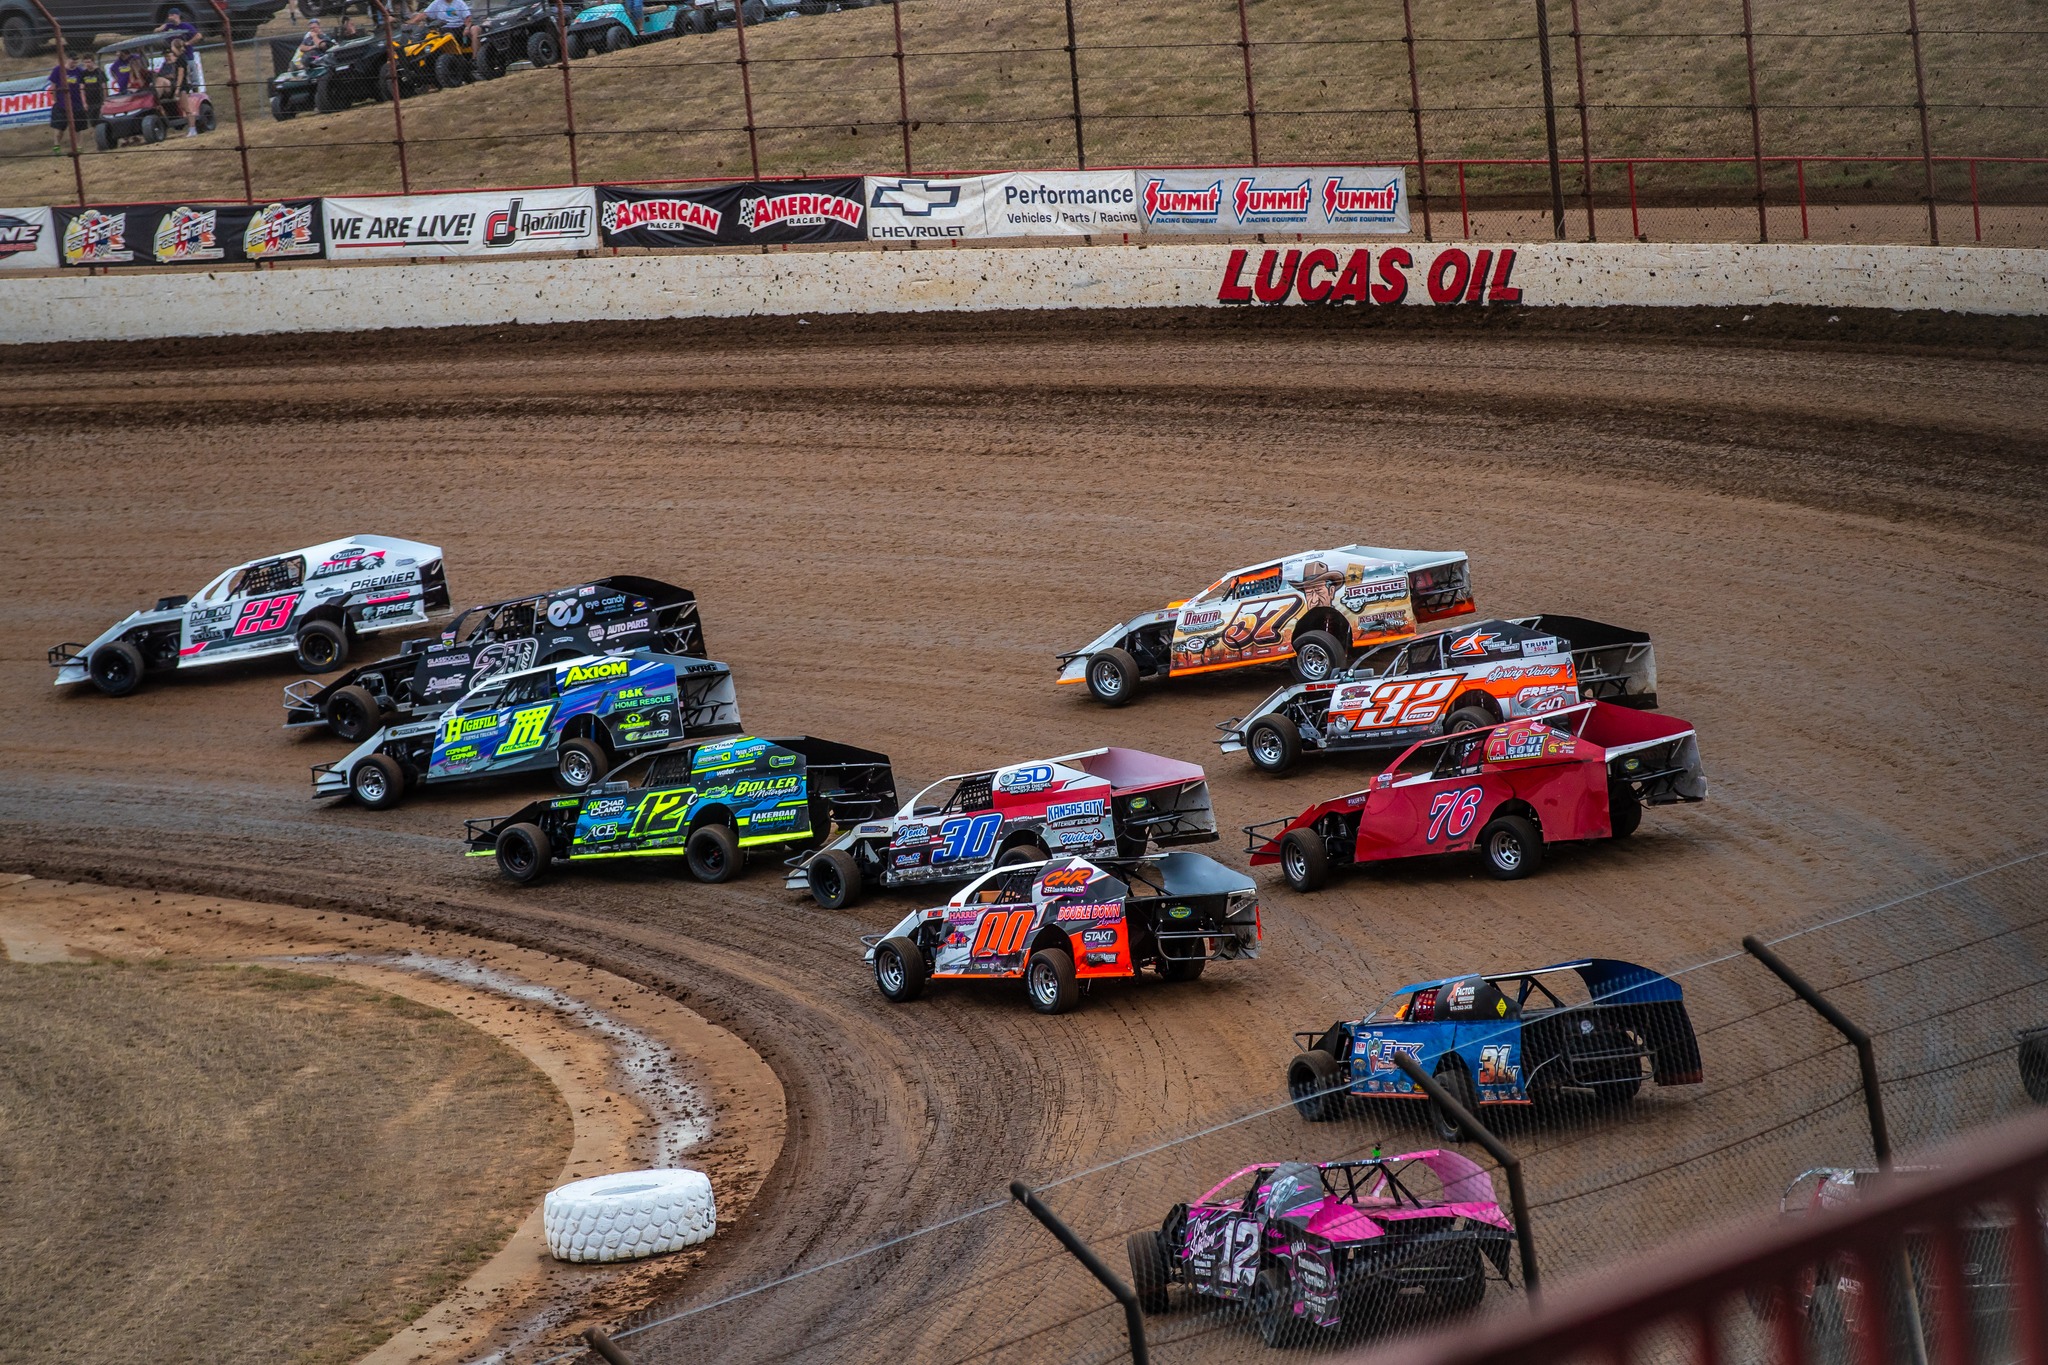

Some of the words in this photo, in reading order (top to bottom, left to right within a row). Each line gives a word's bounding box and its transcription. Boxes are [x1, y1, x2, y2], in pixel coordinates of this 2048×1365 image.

[1005, 184, 1133, 204] Performance
[614, 201, 719, 231] AMERICAN
[753, 195, 861, 227] AMERICAN
[1007, 211, 1052, 223] Vehicles
[1062, 212, 1089, 223] Parts
[1100, 211, 1138, 224] Racing
[331, 218, 361, 240] WE
[367, 216, 413, 239] ARE
[417, 213, 476, 237] LIVE!
[521, 209, 587, 236] RacinDirt
[872, 225, 965, 238] CHEVROLET
[1218, 248, 1412, 303] LUCAS
[1427, 248, 1522, 304] OIL
[317, 560, 357, 575] EAGLE
[351, 571, 415, 590] PREMIER
[1347, 581, 1406, 596] TRIANGLE
[376, 601, 413, 616] RAGE
[585, 600, 600, 609] eye
[601, 594, 627, 605] candy
[233, 593, 300, 636] 23
[1183, 611, 1219, 626] DAKOTA
[1225, 597, 1298, 644] 57
[1359, 610, 1404, 624] ASPHALT
[607, 620, 626, 634] AUTO
[627, 617, 649, 630] PARTS
[1525, 640, 1554, 648] TRUMP
[564, 661, 627, 688] AXIOM
[1486, 665, 1525, 684] Spring
[1526, 665, 1561, 678] Valley
[619, 687, 644, 699] B&K
[1519, 685, 1566, 701] FRESH
[615, 699, 639, 710] HOME
[640, 695, 672, 706] RESCUE
[1537, 697, 1564, 711] CUT
[444, 714, 498, 744] HIGHFILL
[716, 767, 737, 778] water
[734, 777, 798, 797] BOLLER
[590, 805, 625, 816] CLANCY
[599, 800, 624, 809] CHAD
[628, 787, 697, 838] 12
[1048, 802, 1083, 821] KANSAS
[1084, 800, 1103, 817] CITY
[752, 809, 797, 822] LAKEROAD
[758, 815, 795, 823] WAREHOUSE
[1427, 786, 1484, 842] 76
[584, 824, 616, 840] ACE
[1052, 820, 1075, 828] INTERIOR
[896, 824, 929, 847] Jones
[931, 813, 1003, 864] 30
[1060, 828, 1104, 844] Willey's
[1044, 869, 1091, 886] CHR
[949, 910, 978, 920] HARRIS
[1057, 906, 1091, 920] DOUBLE
[1092, 903, 1121, 919] DOWN
[972, 910, 1036, 957] 00
[1084, 931, 1114, 942] STAKT
[1455, 986, 1475, 997] FACTOR
[1480, 1045, 1511, 1086] 31
[1219, 1218, 1259, 1287] 12
